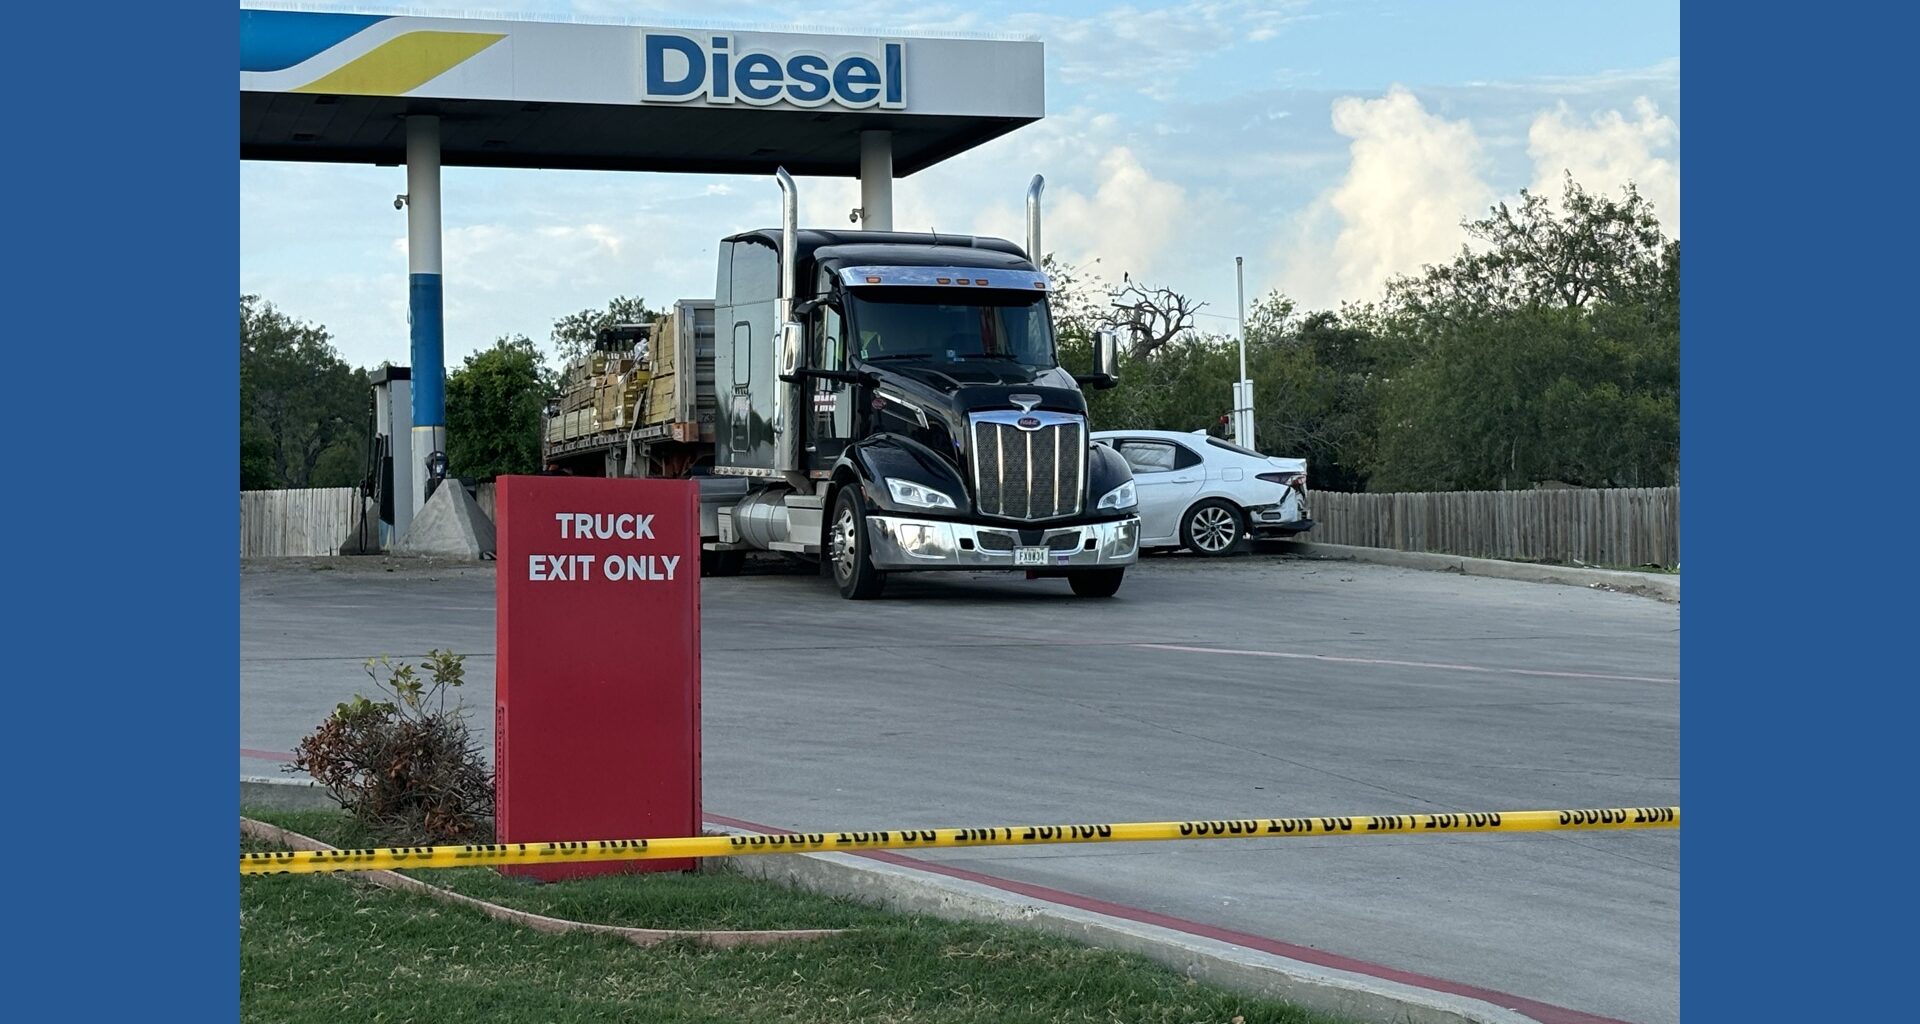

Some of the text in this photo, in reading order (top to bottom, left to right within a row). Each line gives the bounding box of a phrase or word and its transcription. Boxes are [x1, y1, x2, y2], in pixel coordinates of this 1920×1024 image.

[645, 34, 903, 103] Diesel
[555, 512, 656, 540] TRUCK
[528, 554, 681, 582] EXIT ONLY
